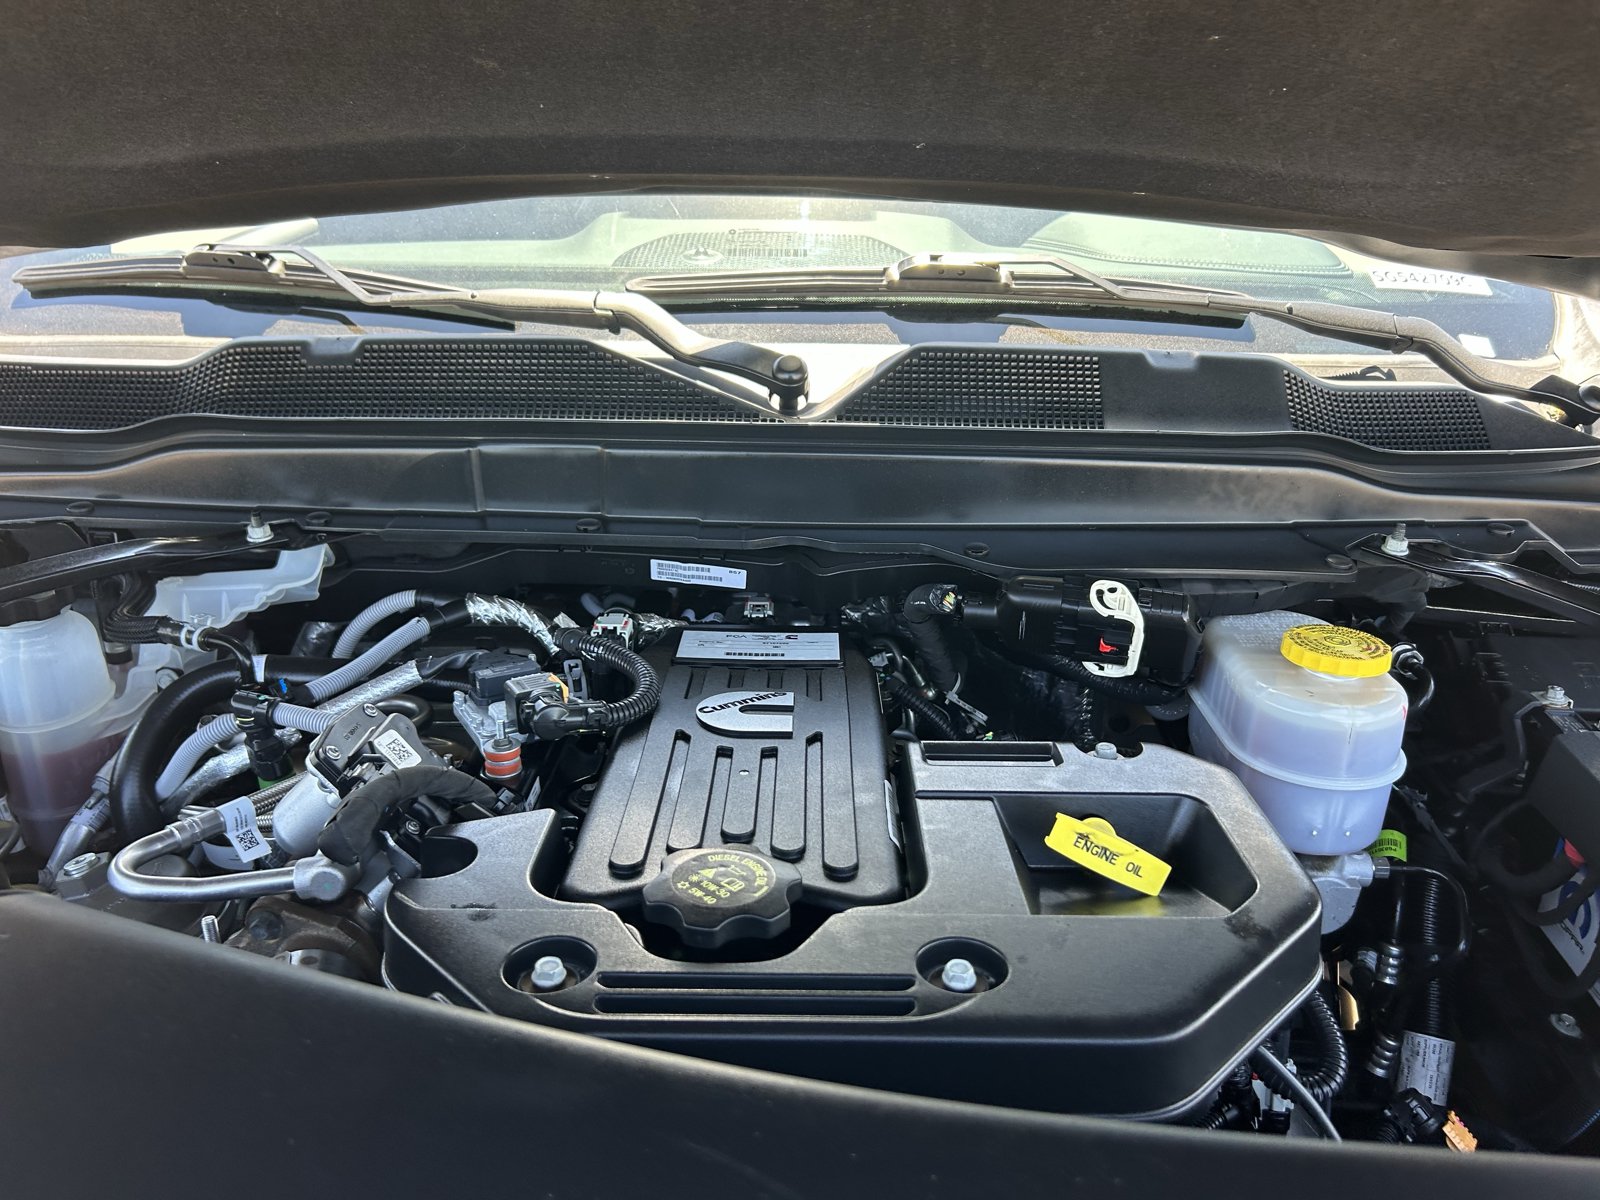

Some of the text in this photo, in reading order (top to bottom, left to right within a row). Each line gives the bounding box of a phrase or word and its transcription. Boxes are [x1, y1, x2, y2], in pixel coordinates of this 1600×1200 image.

[698, 691, 787, 714] Cummins
[707, 853, 740, 863] DIESEL
[1073, 835, 1143, 878] ENGINE OIL
